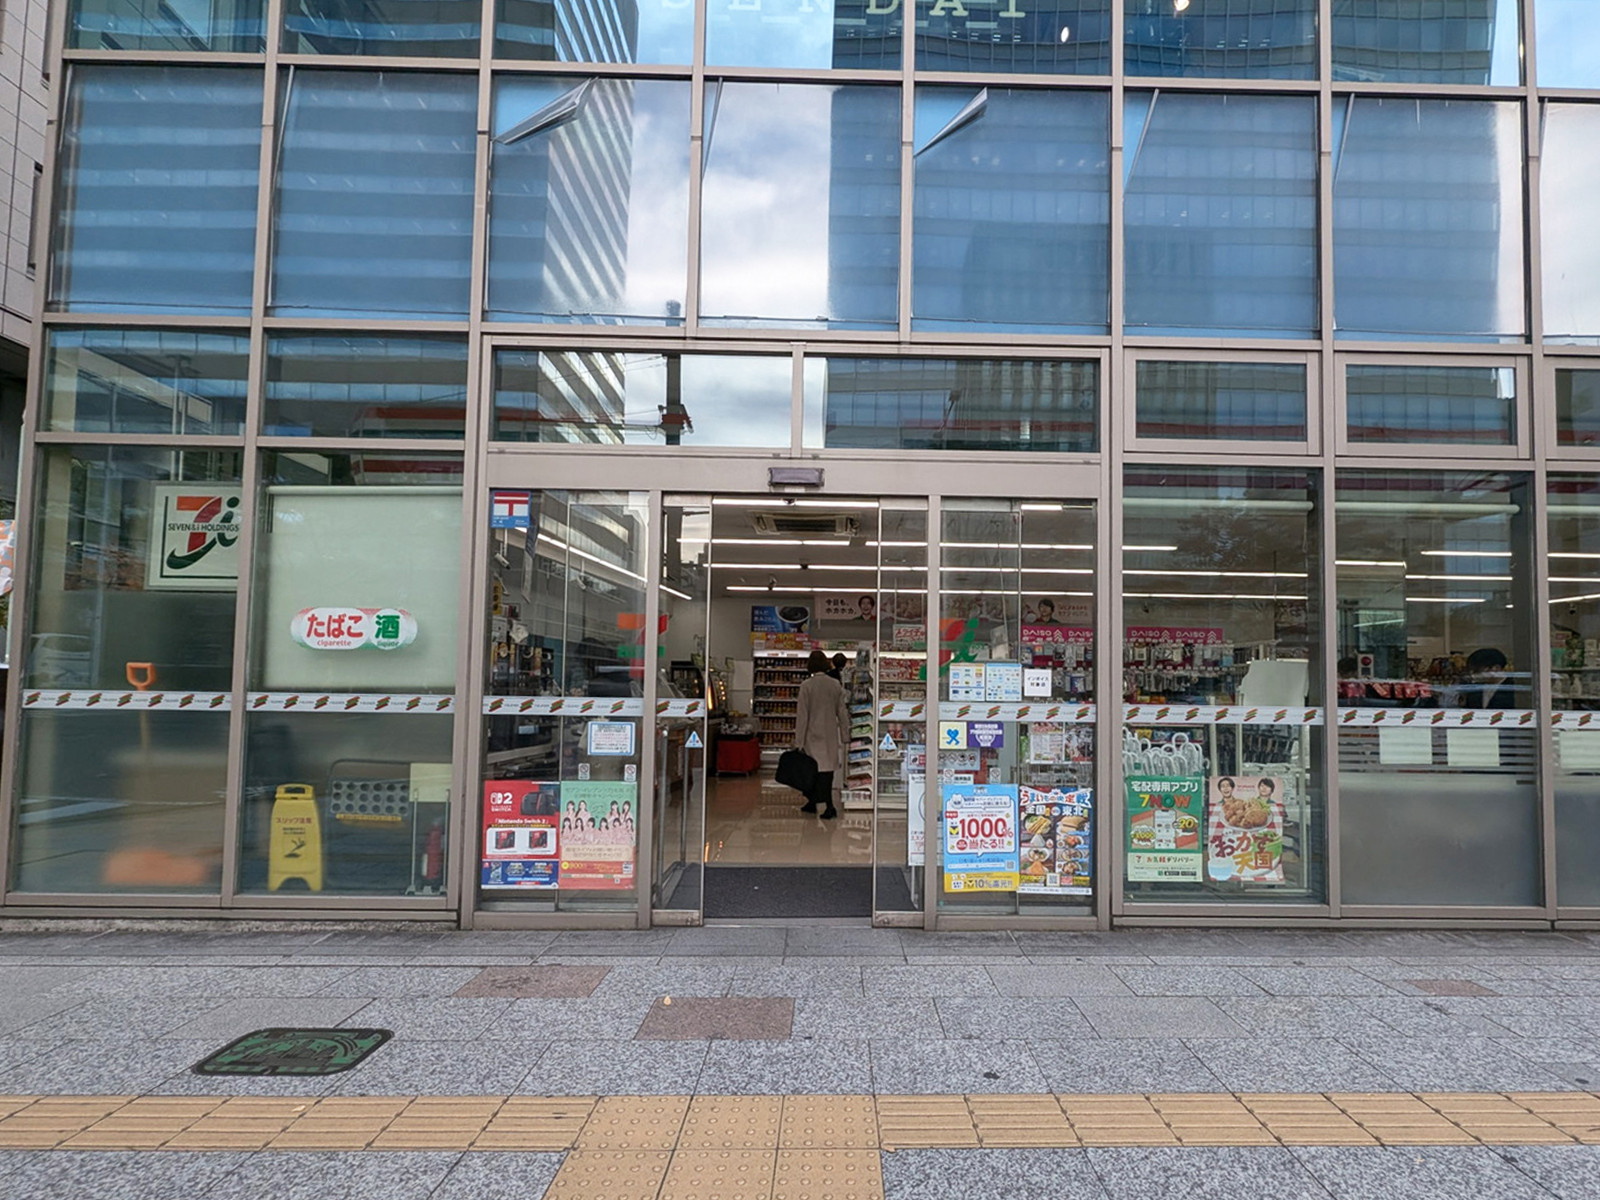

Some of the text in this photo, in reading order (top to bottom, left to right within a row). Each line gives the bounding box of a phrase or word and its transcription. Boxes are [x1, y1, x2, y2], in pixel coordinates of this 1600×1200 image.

[201, 524, 239, 532] HOLDINGS
[306, 614, 400, 639] たばこ 酒
[1131, 781, 1198, 792] 宅配専用アプリ
[1139, 794, 1191, 809] 7NOW
